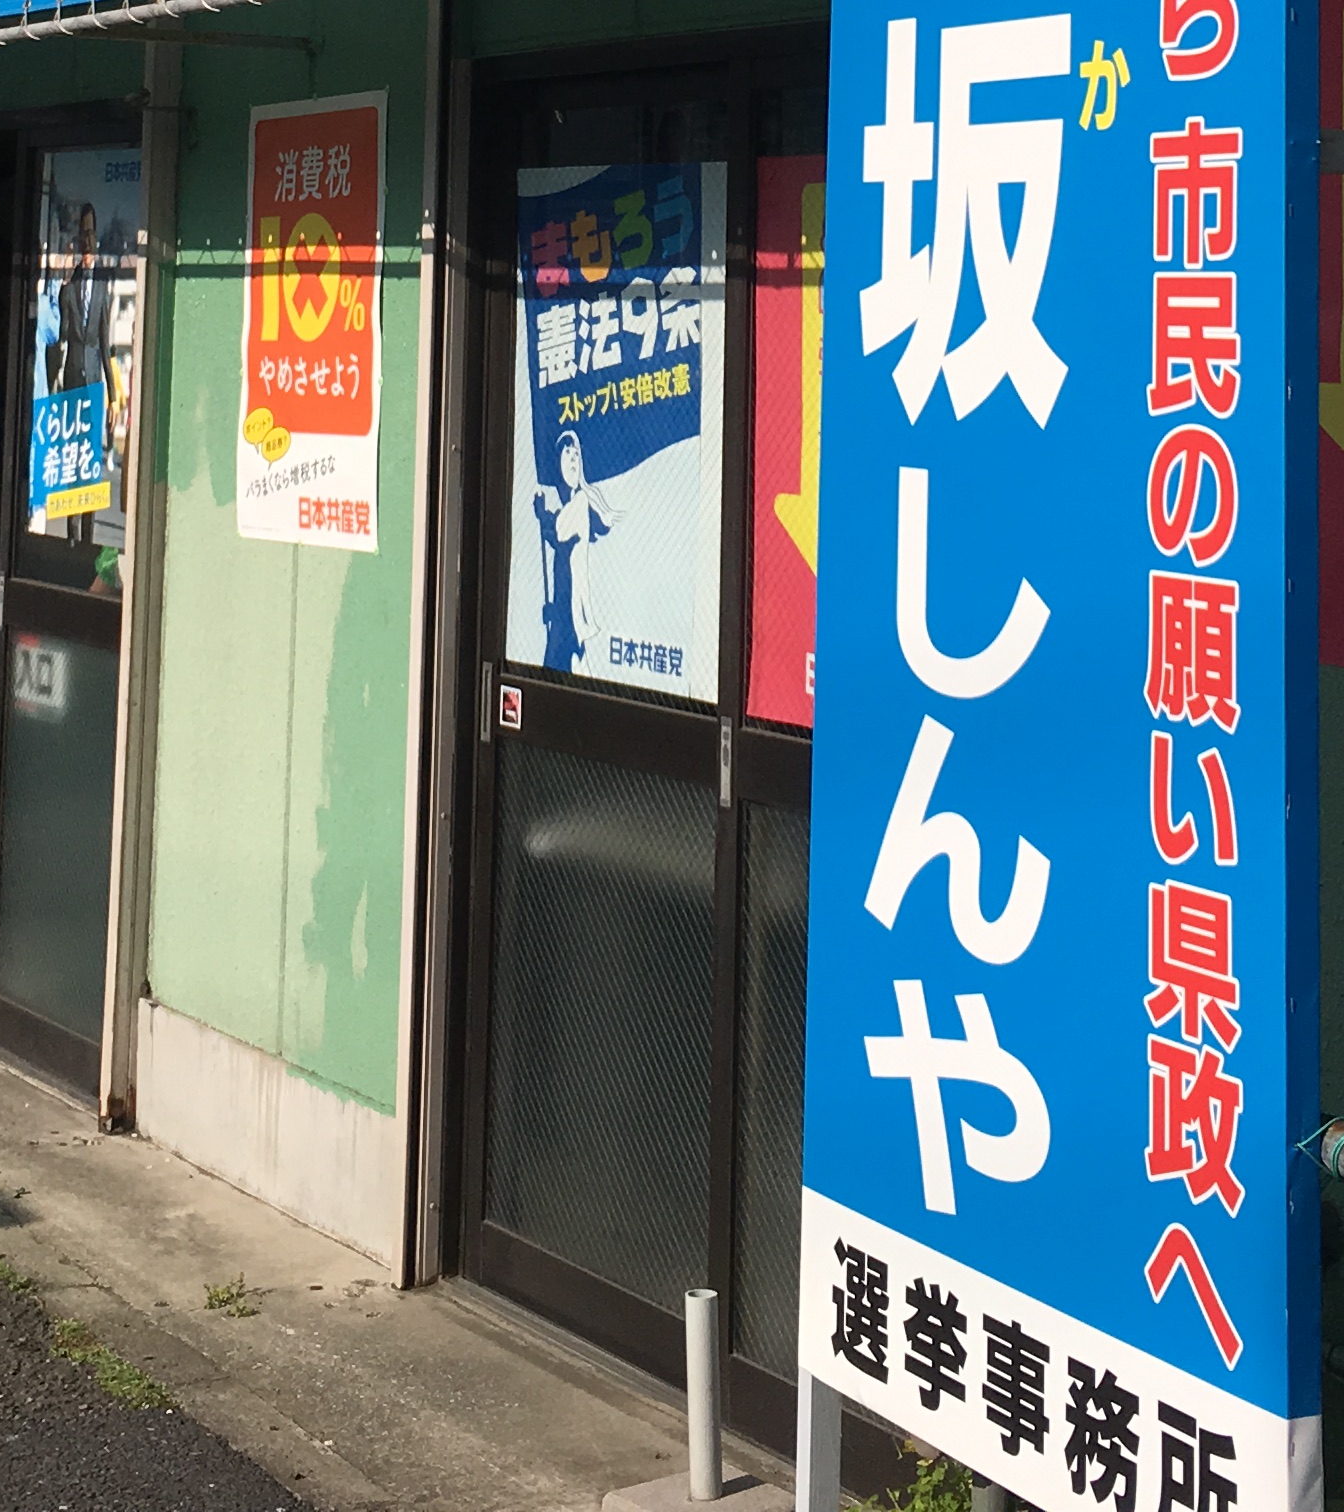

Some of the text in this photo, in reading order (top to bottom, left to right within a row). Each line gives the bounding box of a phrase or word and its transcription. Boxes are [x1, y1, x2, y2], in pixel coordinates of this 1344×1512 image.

[274, 142, 353, 202] 消費税
[529, 176, 693, 296] まもろう
[259, 212, 366, 343] 10%
[536, 265, 701, 389] 憲法9条
[258, 354, 361, 400] やめさせよう
[35, 398, 92, 445] くらしに
[42, 438, 102, 488] 希望を。
[298, 496, 371, 535] 日本共産党
[608, 635, 683, 678] 日本共産党
[830, 1235, 1239, 1512] 選挙事務所
